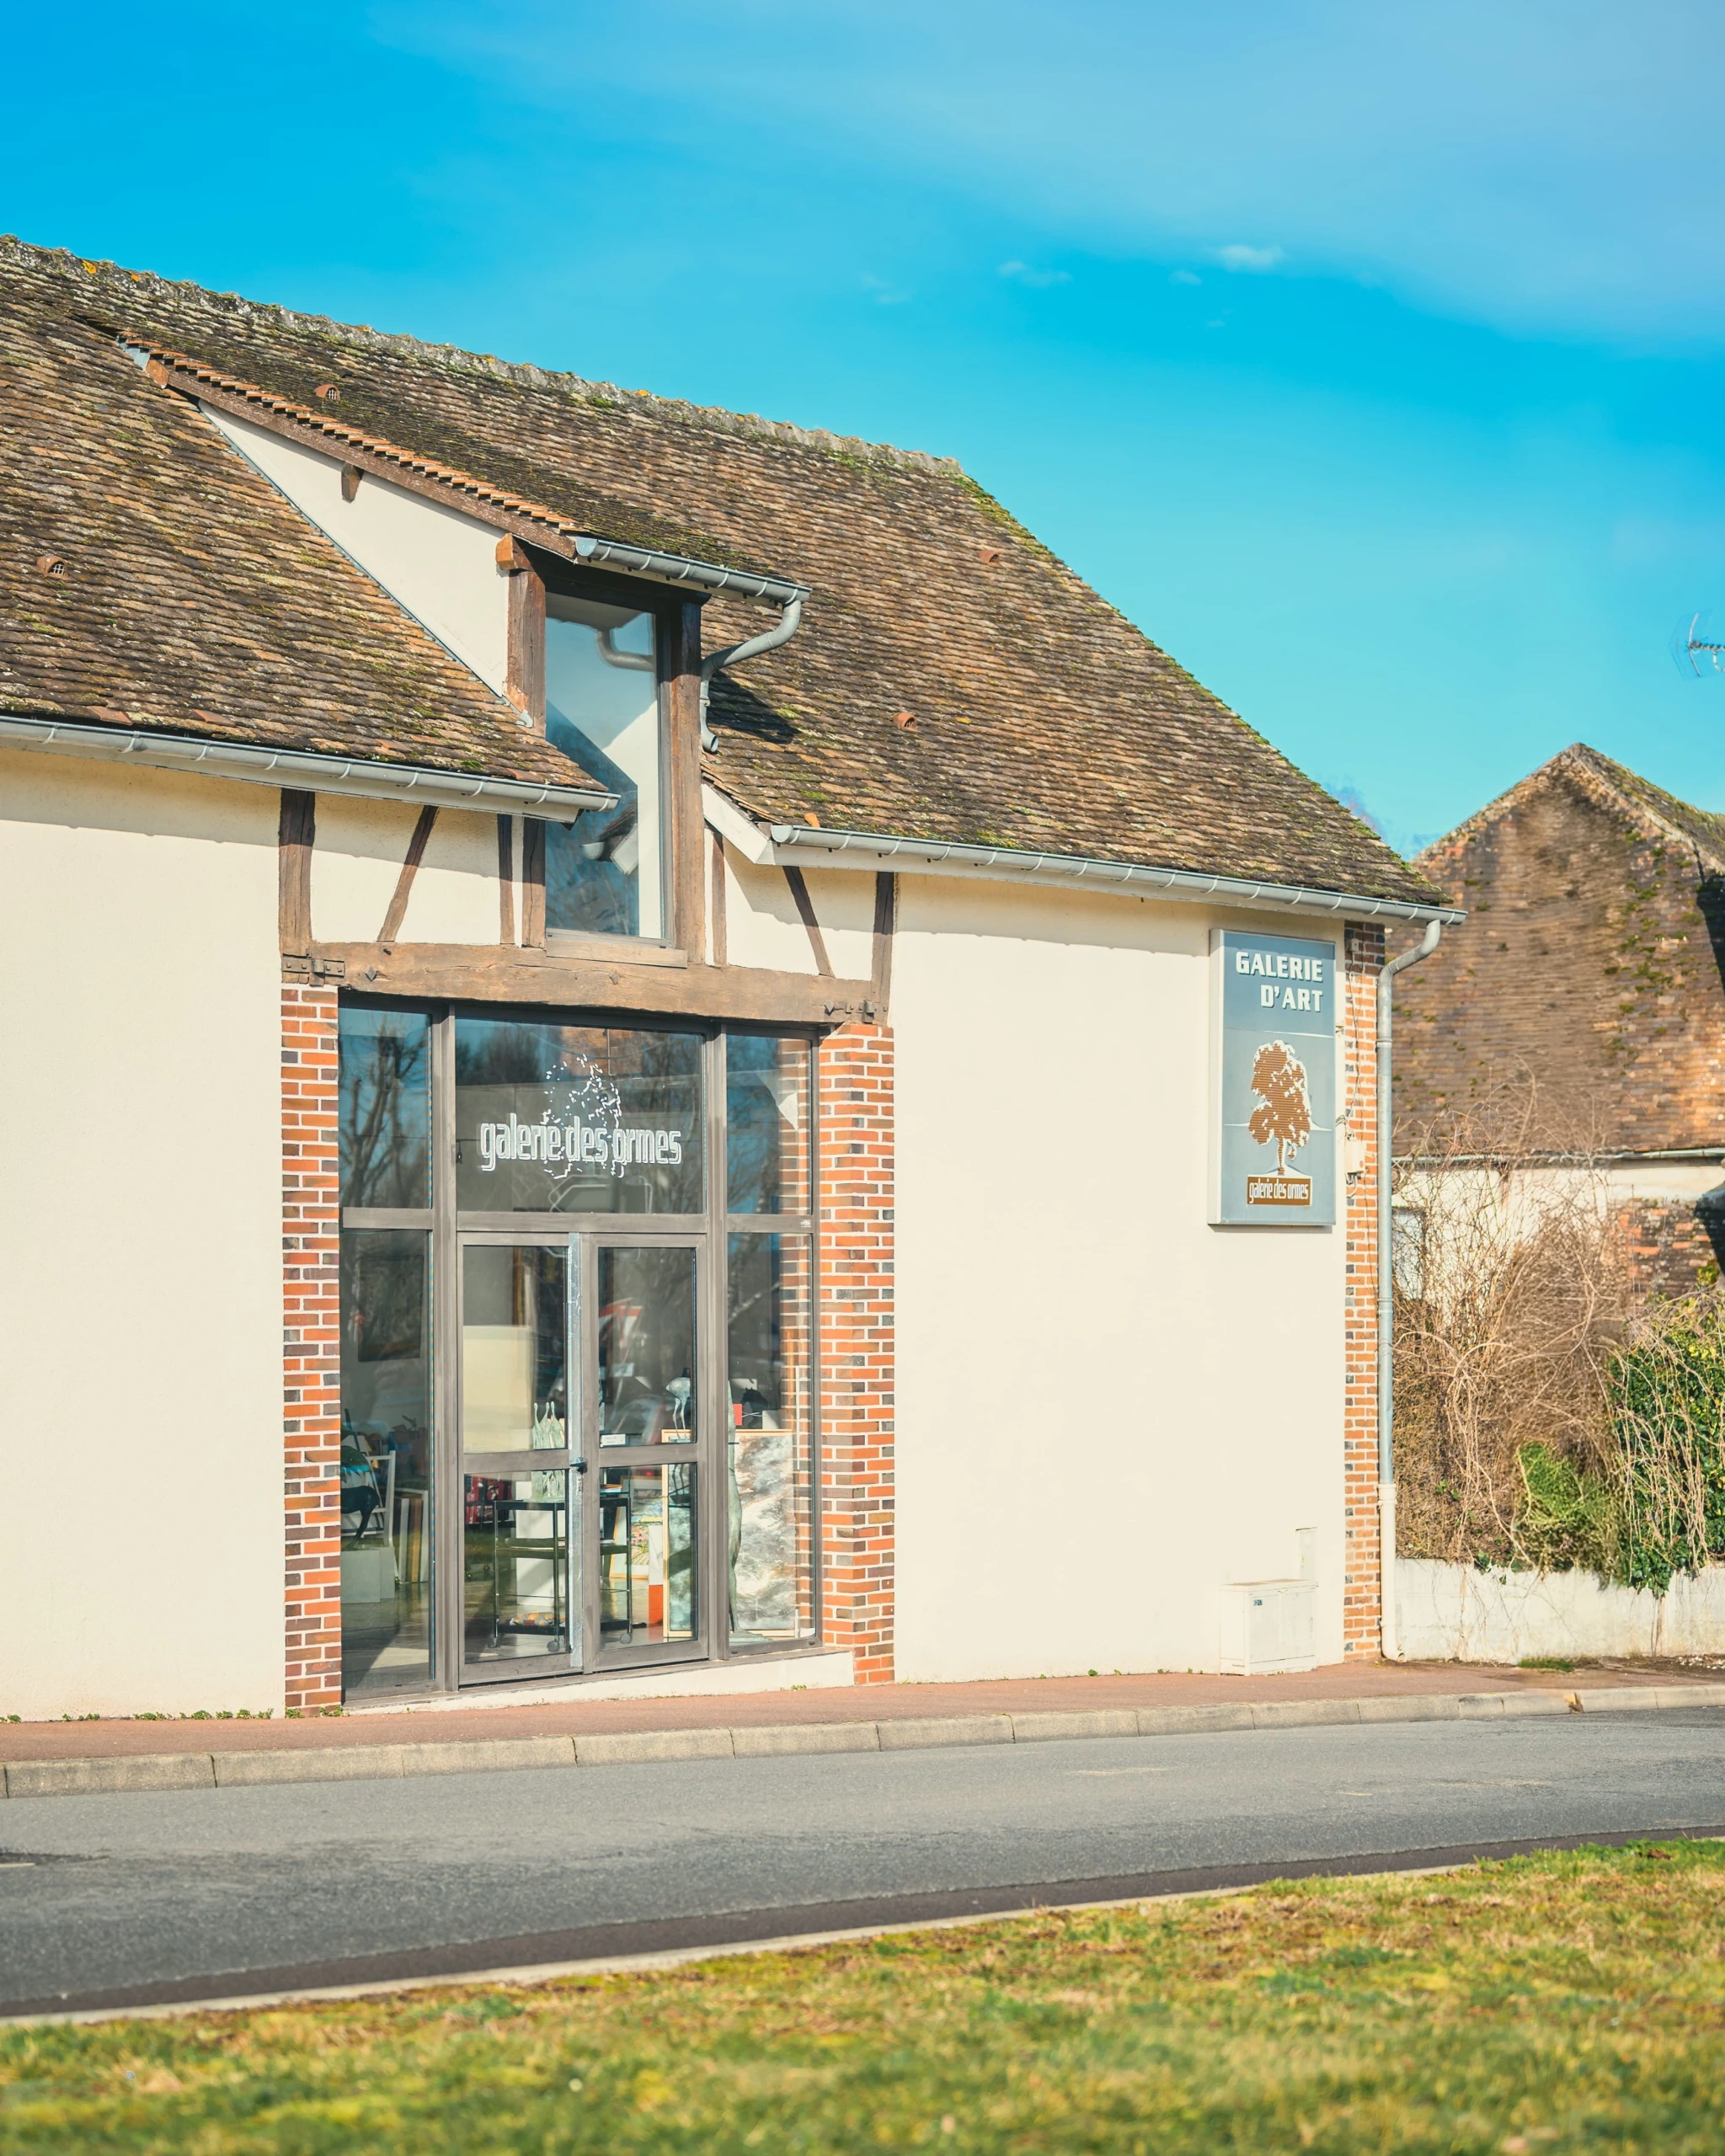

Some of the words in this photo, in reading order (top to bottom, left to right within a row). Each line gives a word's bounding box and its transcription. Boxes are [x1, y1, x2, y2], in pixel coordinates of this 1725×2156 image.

[1236, 951, 1323, 983] GALERIE
[1260, 985, 1323, 1012] D'ART
[479, 1113, 561, 1171] galerie
[565, 1115, 608, 1163] des
[612, 1128, 682, 1165] ormes
[1248, 1177, 1273, 1204] galerie
[1274, 1178, 1287, 1199] des
[1287, 1183, 1309, 1200] ormes
